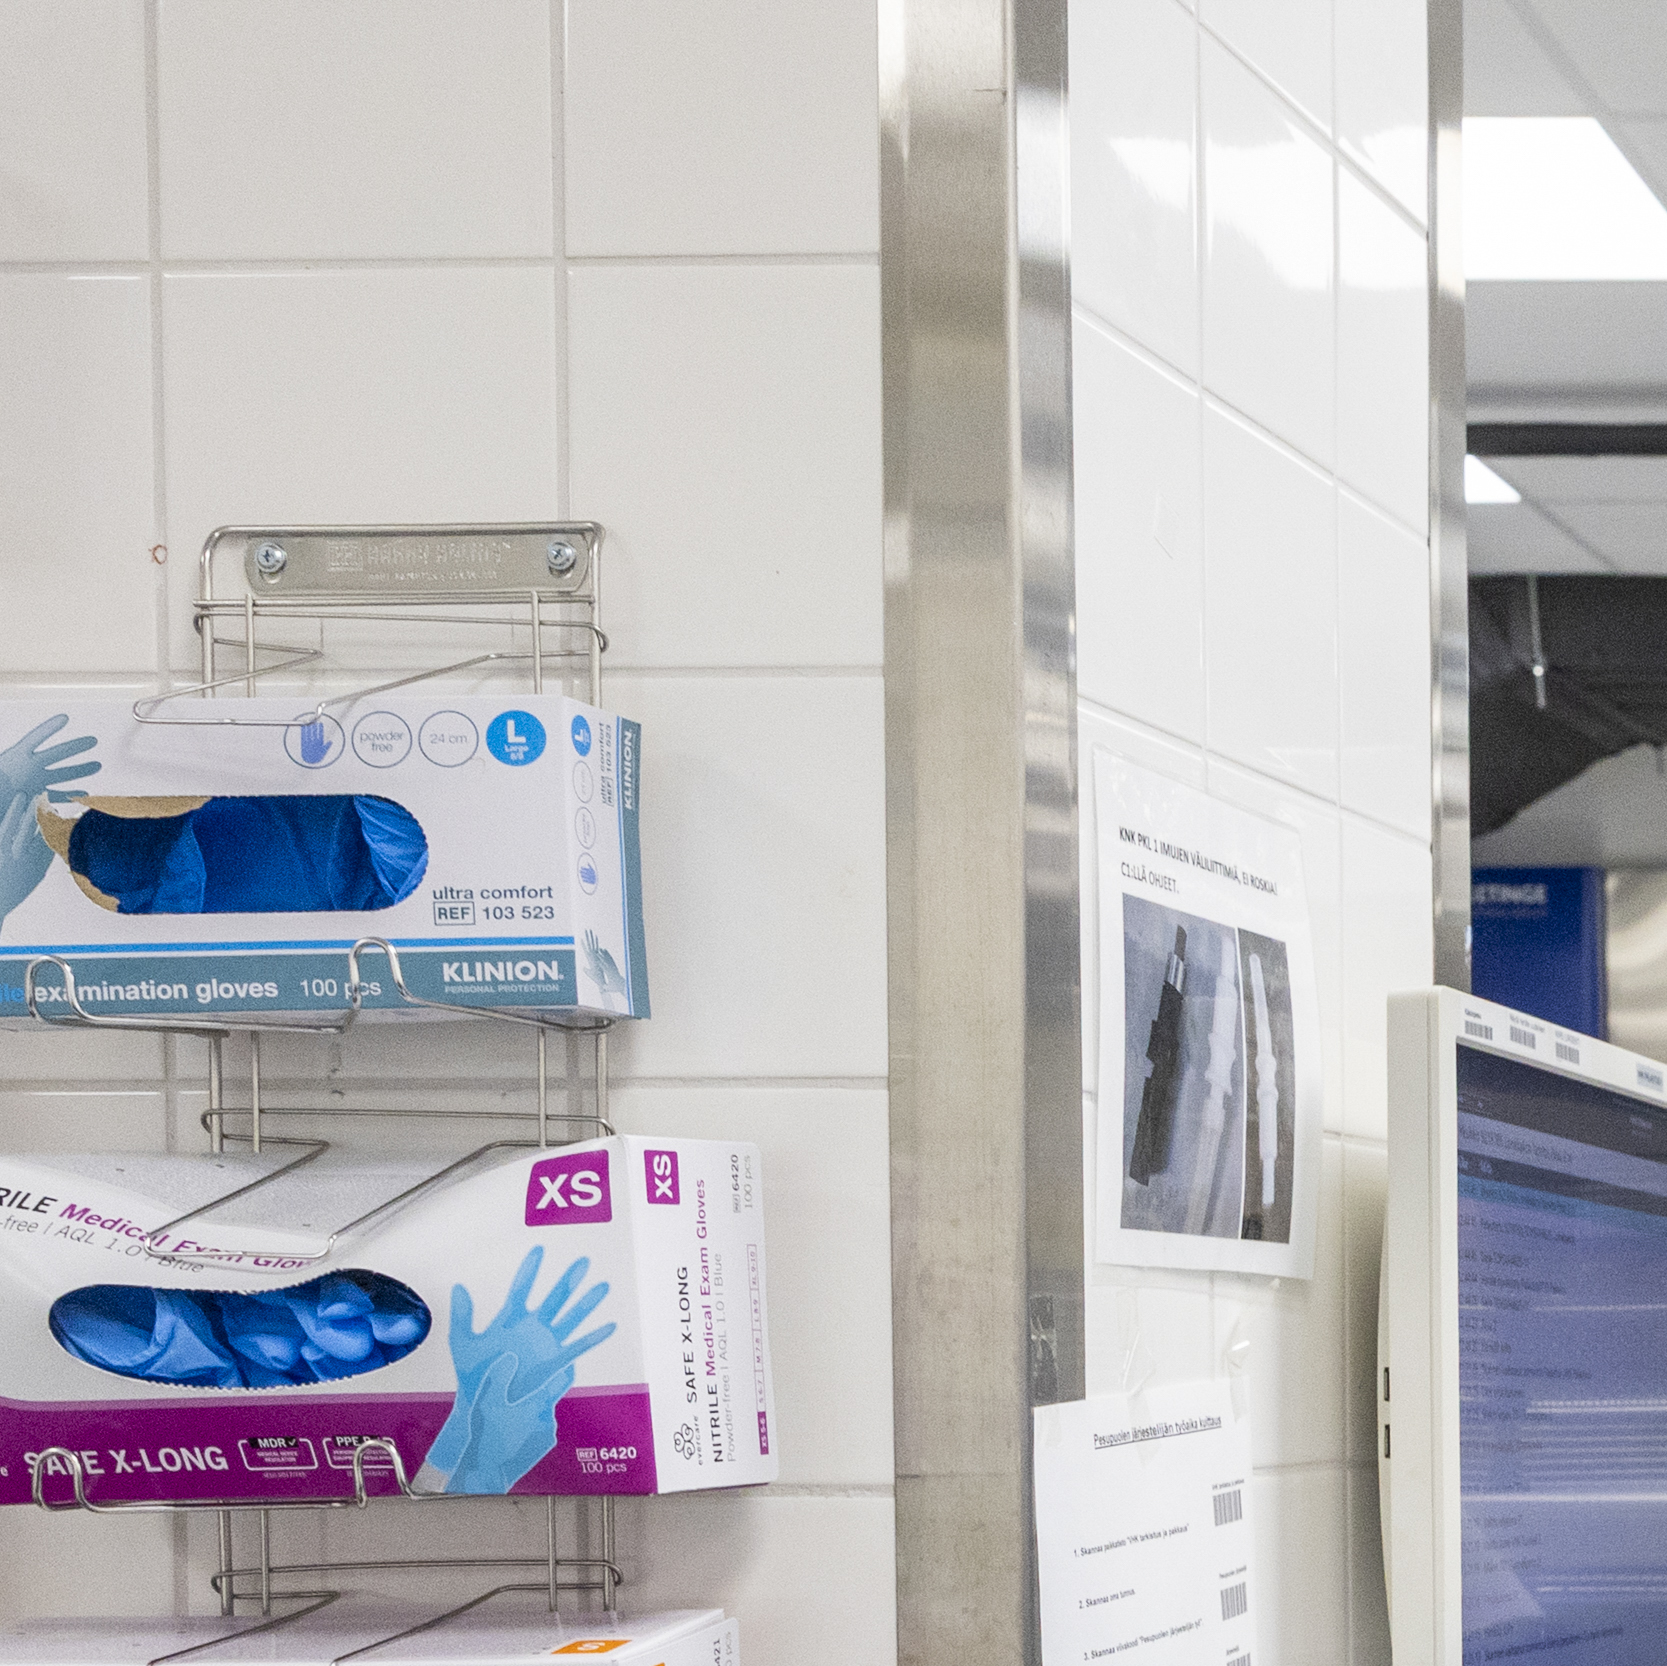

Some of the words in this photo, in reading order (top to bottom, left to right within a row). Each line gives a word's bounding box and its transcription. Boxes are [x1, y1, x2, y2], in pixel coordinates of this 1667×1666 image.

[360, 731, 403, 743] powder
[430, 734, 445, 744] 24
[448, 735, 467, 744] cm
[506, 719, 526, 744] L
[371, 742, 393, 753] free
[624, 730, 633, 810] KLINION
[1118, 826, 1136, 844] KNK
[1137, 833, 1152, 851] PKL
[1154, 839, 1158, 853] 1
[1160, 841, 1189, 864] IMUJEN
[1242, 871, 1249, 886] EI
[1121, 862, 1148, 883] C1:LLÄ
[432, 887, 475, 900] ultra
[480, 885, 553, 900] comfort
[437, 907, 471, 920] REF
[482, 906, 516, 920] 103
[521, 906, 555, 920] 523
[442, 961, 560, 984] KLINION
[196, 978, 279, 1004] gloves
[300, 980, 337, 997] 100
[652, 1153, 674, 1200] XS
[730, 1154, 739, 1192] 6420
[535, 1170, 603, 1210] XS
[696, 1179, 708, 1239] Gloves
[53, 1223, 94, 1246] AQL
[58, 1203, 170, 1248] Medical
[700, 1247, 711, 1296] Exam
[714, 1253, 724, 1287] Blue
[677, 1267, 693, 1344] X-LONG
[703, 1304, 717, 1376] Medical
[717, 1330, 728, 1360] AQL
[683, 1352, 697, 1403] SAFE
[707, 1384, 724, 1462] NITRILE
[723, 1374, 737, 1462] Powder-free
[258, 1438, 288, 1449] MDR
[336, 1435, 360, 1447] PPE
[600, 1447, 637, 1460] 6420
[110, 1447, 229, 1475] X-LONG
[582, 1461, 604, 1473] 100
[606, 1463, 627, 1474] pcs
[576, 1641, 606, 1651] S
